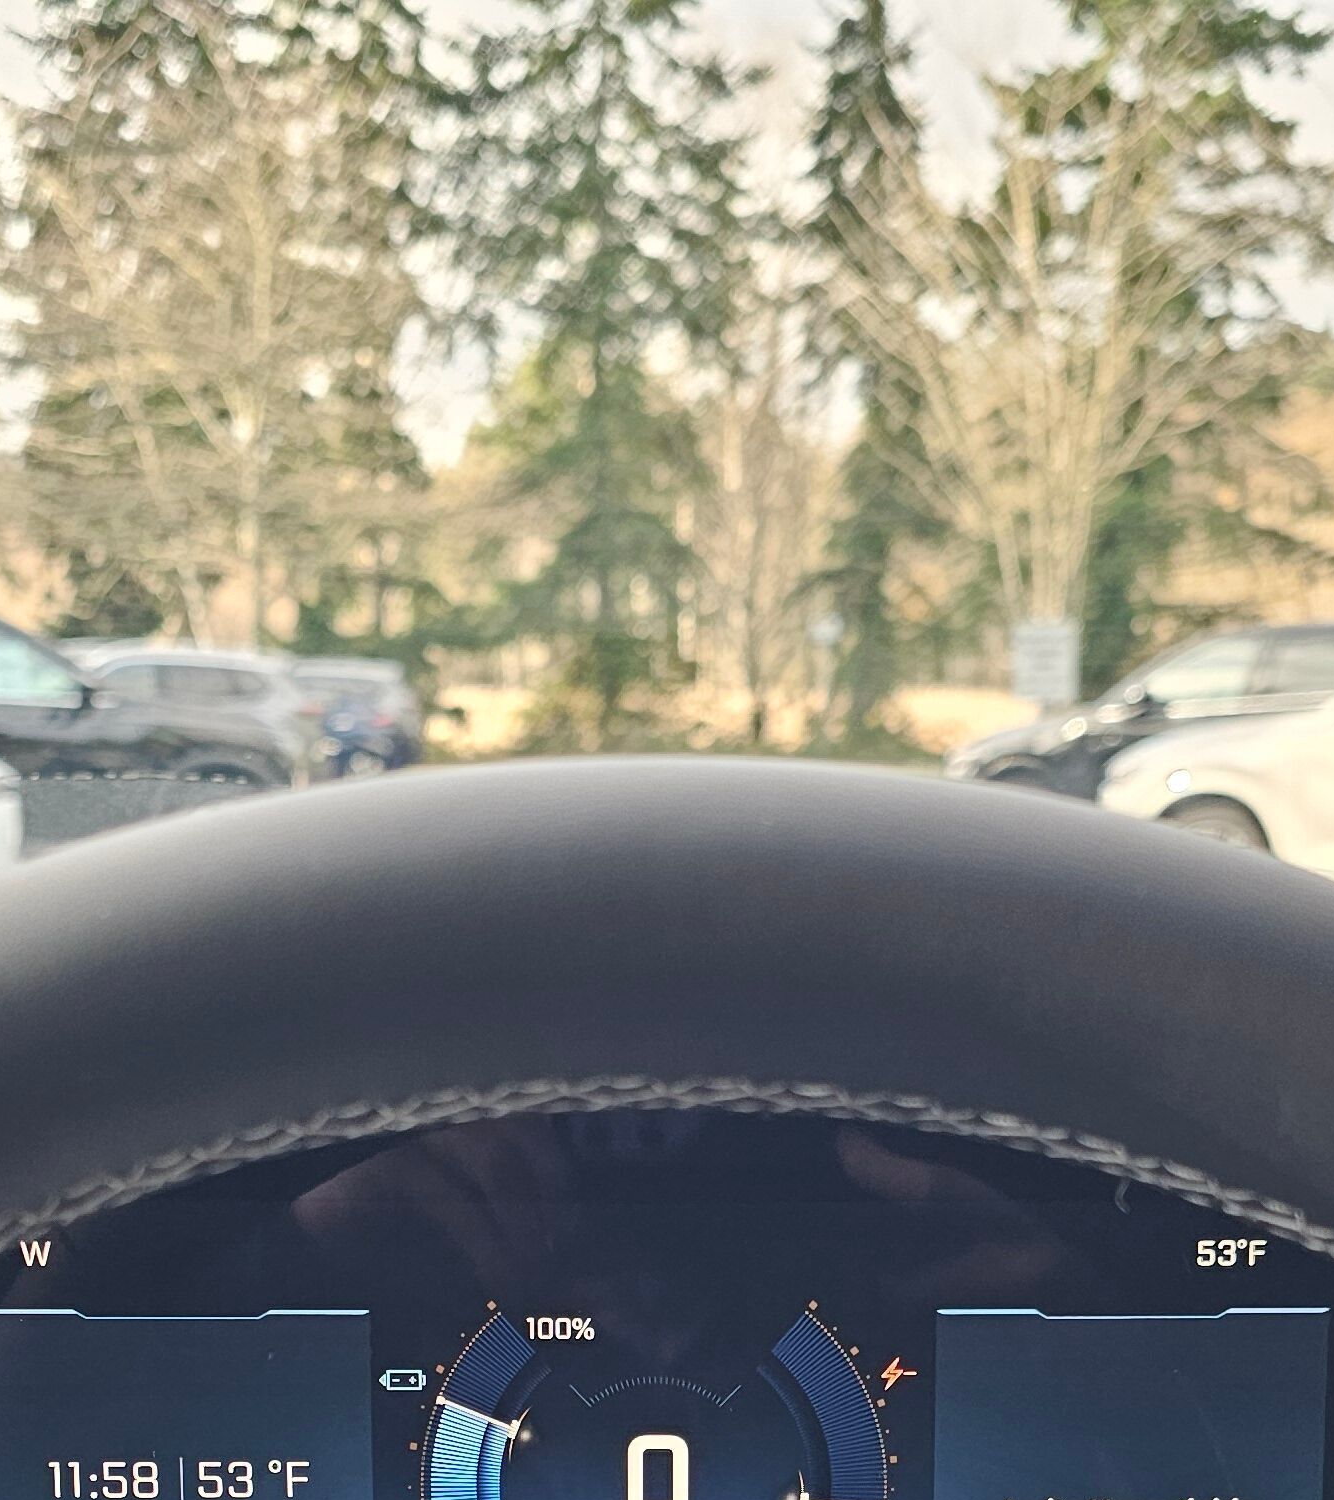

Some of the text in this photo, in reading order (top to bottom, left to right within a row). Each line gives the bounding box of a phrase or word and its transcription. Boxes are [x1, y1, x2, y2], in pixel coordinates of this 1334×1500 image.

[19, 1240, 52, 1267] W
[1196, 1238, 1268, 1267] 53°F
[525, 1316, 595, 1341] 100%
[48, 1461, 159, 1500] 11:58
[197, 1461, 254, 1499] 53
